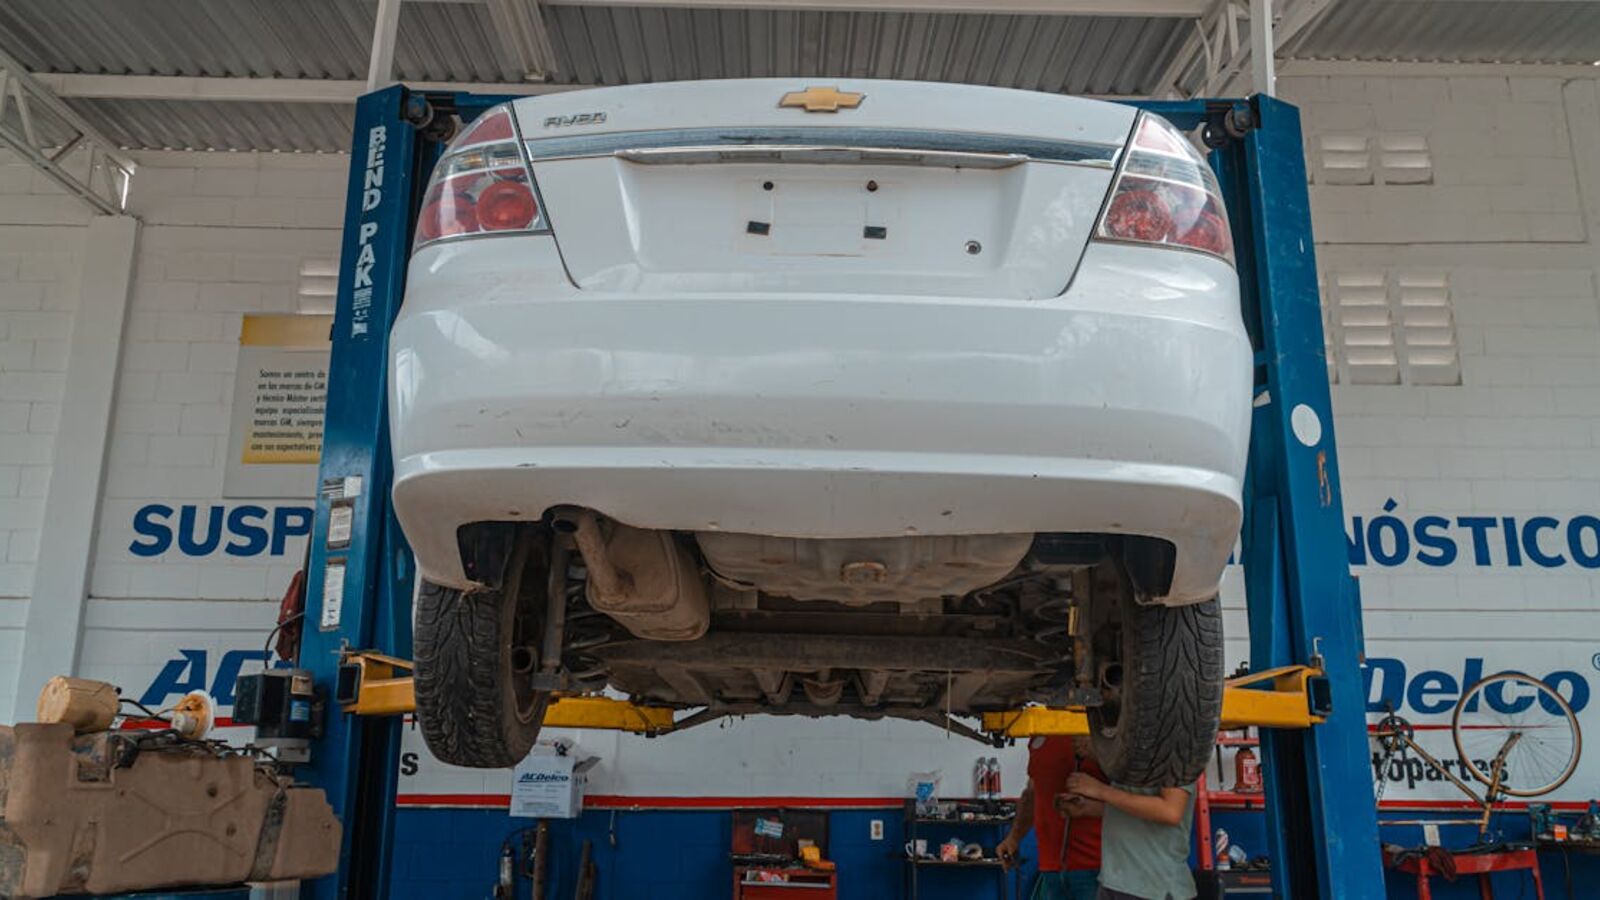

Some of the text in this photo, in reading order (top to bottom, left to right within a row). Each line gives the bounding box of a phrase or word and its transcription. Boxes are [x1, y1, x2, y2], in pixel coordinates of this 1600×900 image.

[362, 126, 387, 212] BEND
[353, 221, 379, 289] PAK
[129, 504, 314, 556] SUSP
